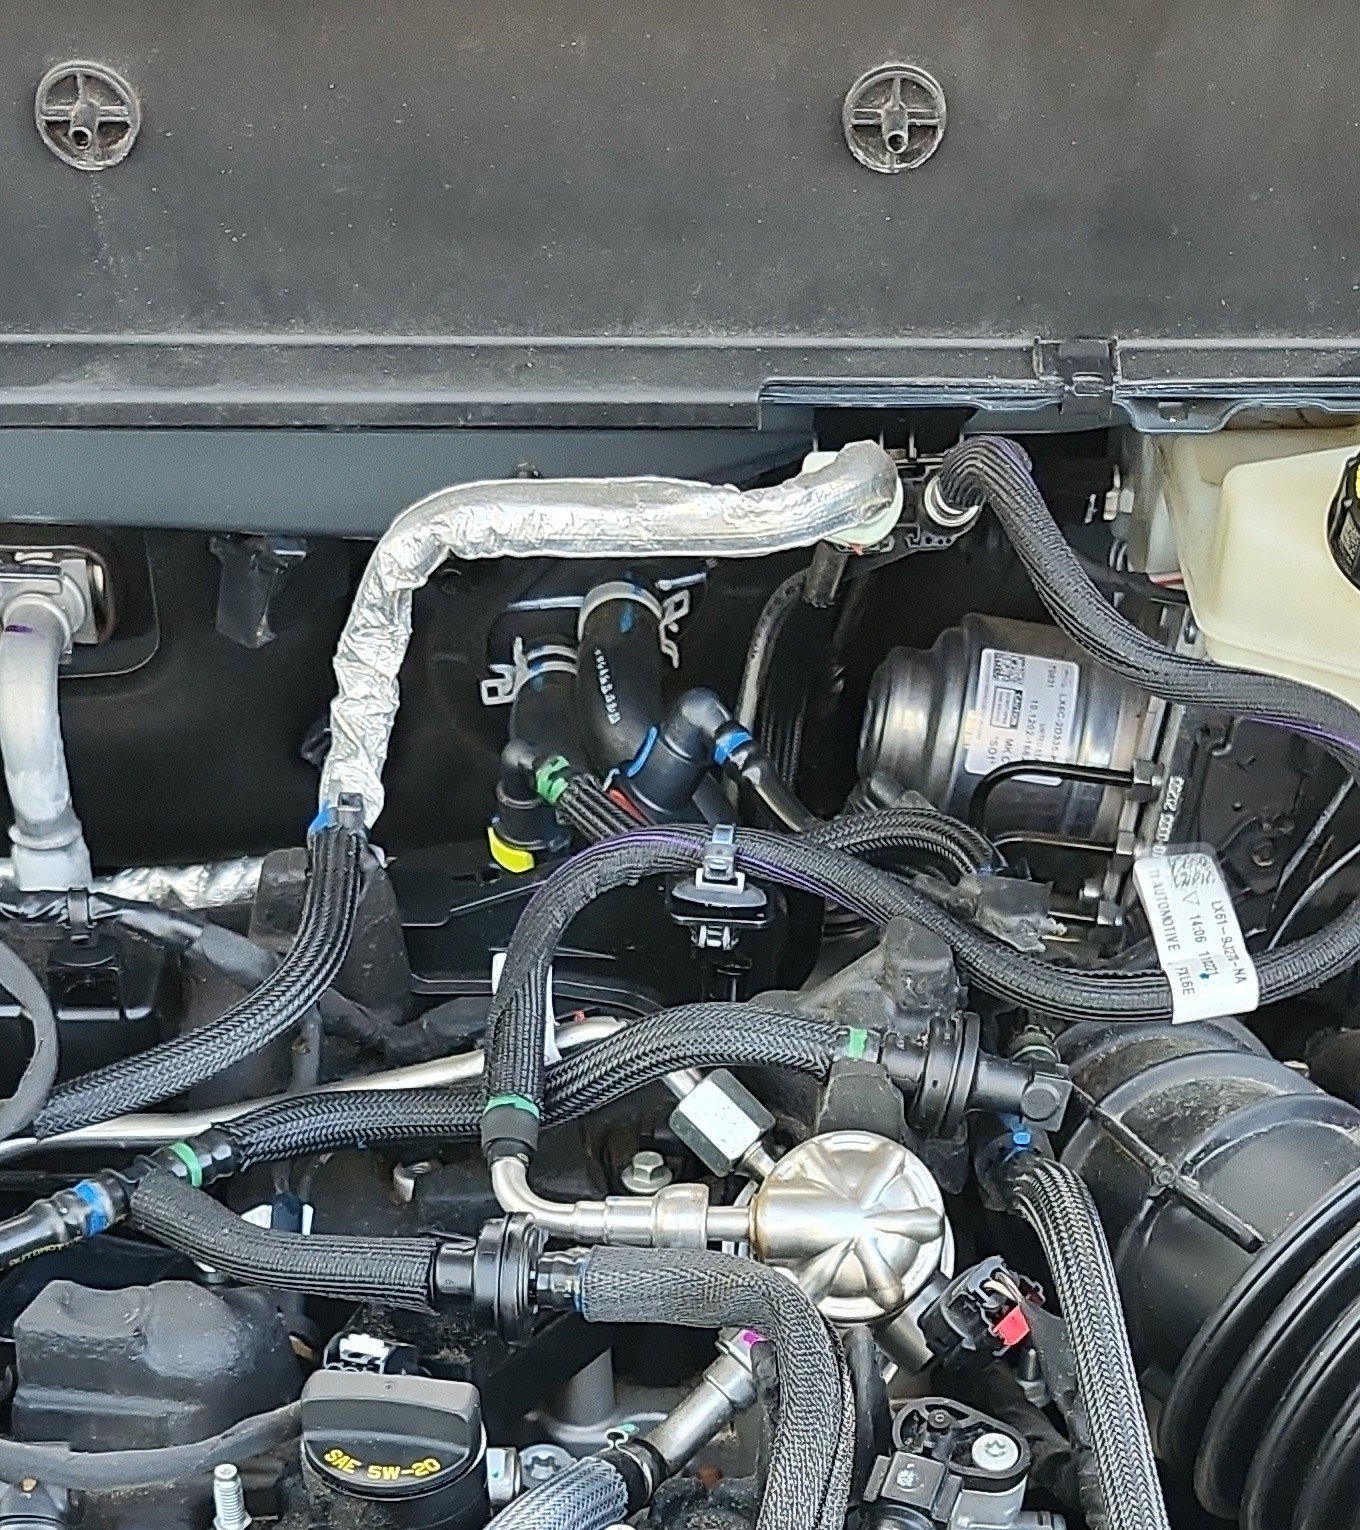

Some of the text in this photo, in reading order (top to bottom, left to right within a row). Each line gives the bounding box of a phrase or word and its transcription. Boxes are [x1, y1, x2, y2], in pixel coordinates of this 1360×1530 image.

[1153, 882, 1181, 951] AUTOMOTIVE
[1188, 914, 1208, 943] 14:06
[324, 1448, 442, 1480] SAE 5W-20
